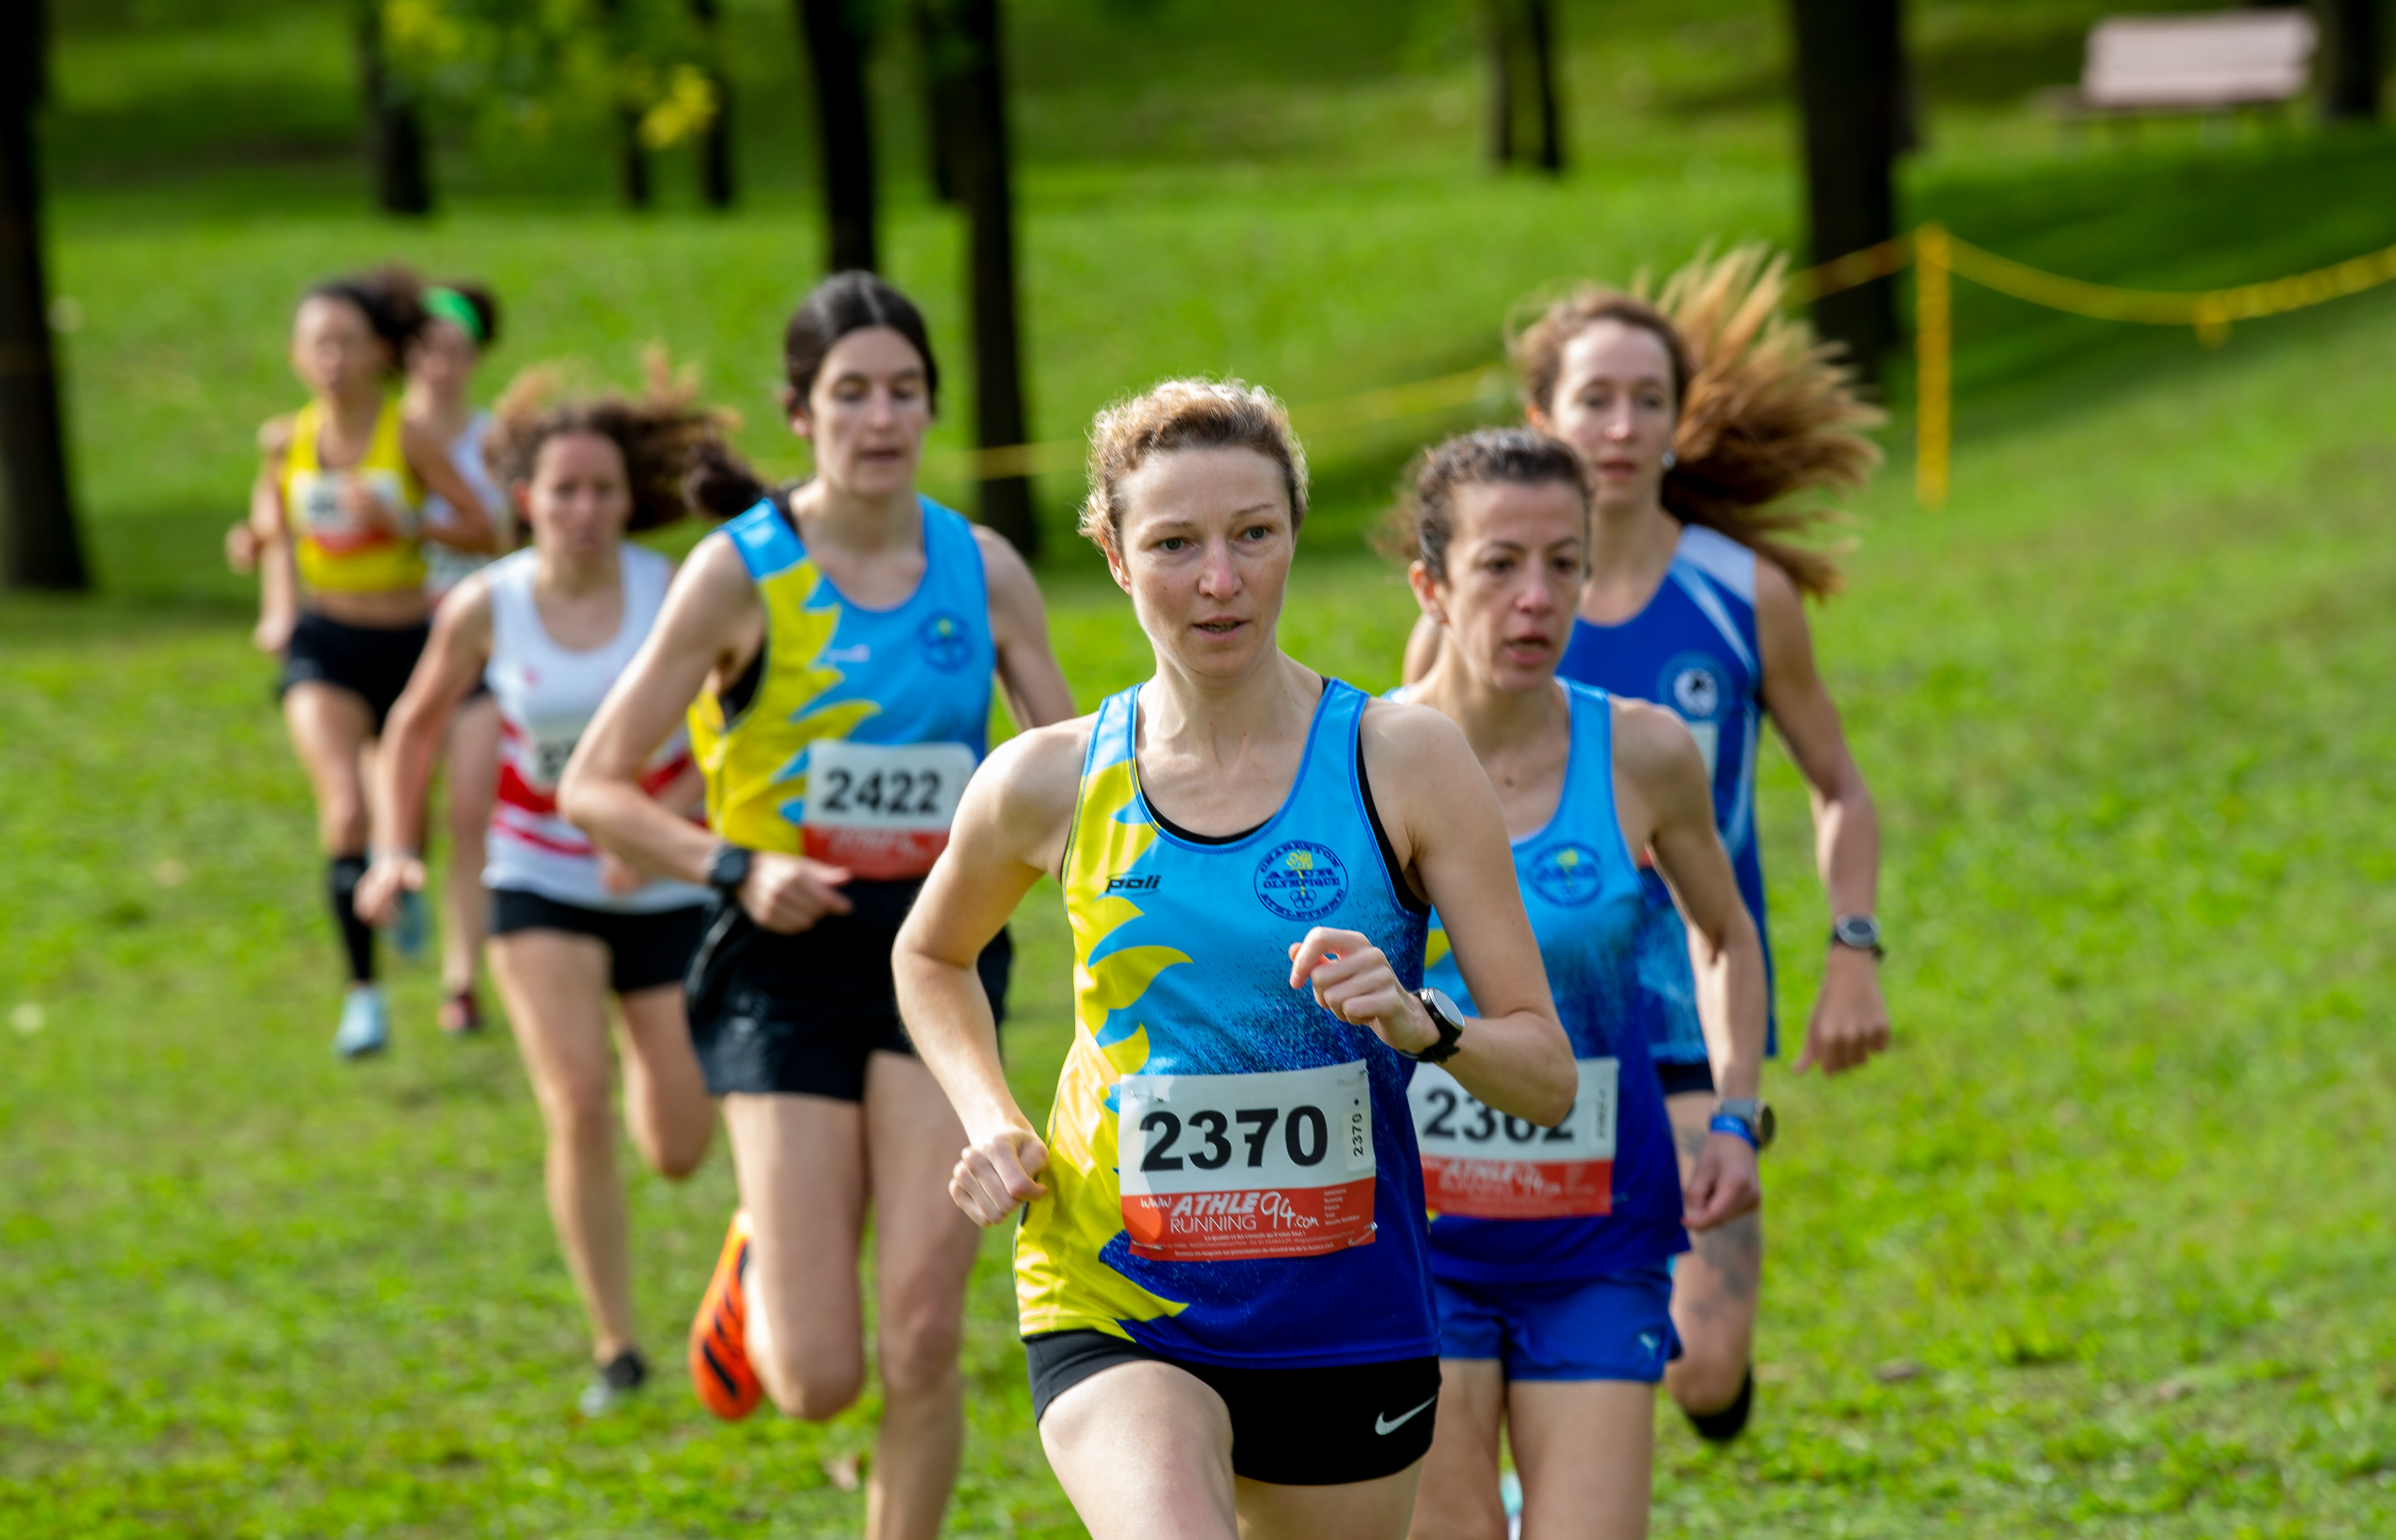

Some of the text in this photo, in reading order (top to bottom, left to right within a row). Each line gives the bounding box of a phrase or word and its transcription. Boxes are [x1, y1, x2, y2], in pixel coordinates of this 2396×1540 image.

[821, 765, 942, 814] 2422
[1105, 875, 1161, 892] poli
[1139, 1105, 1328, 1172] 2370
[1351, 1113, 1364, 1157] 2370
[1171, 1191, 1260, 1217] ATHLE
[1170, 1214, 1257, 1234] RUNNING
